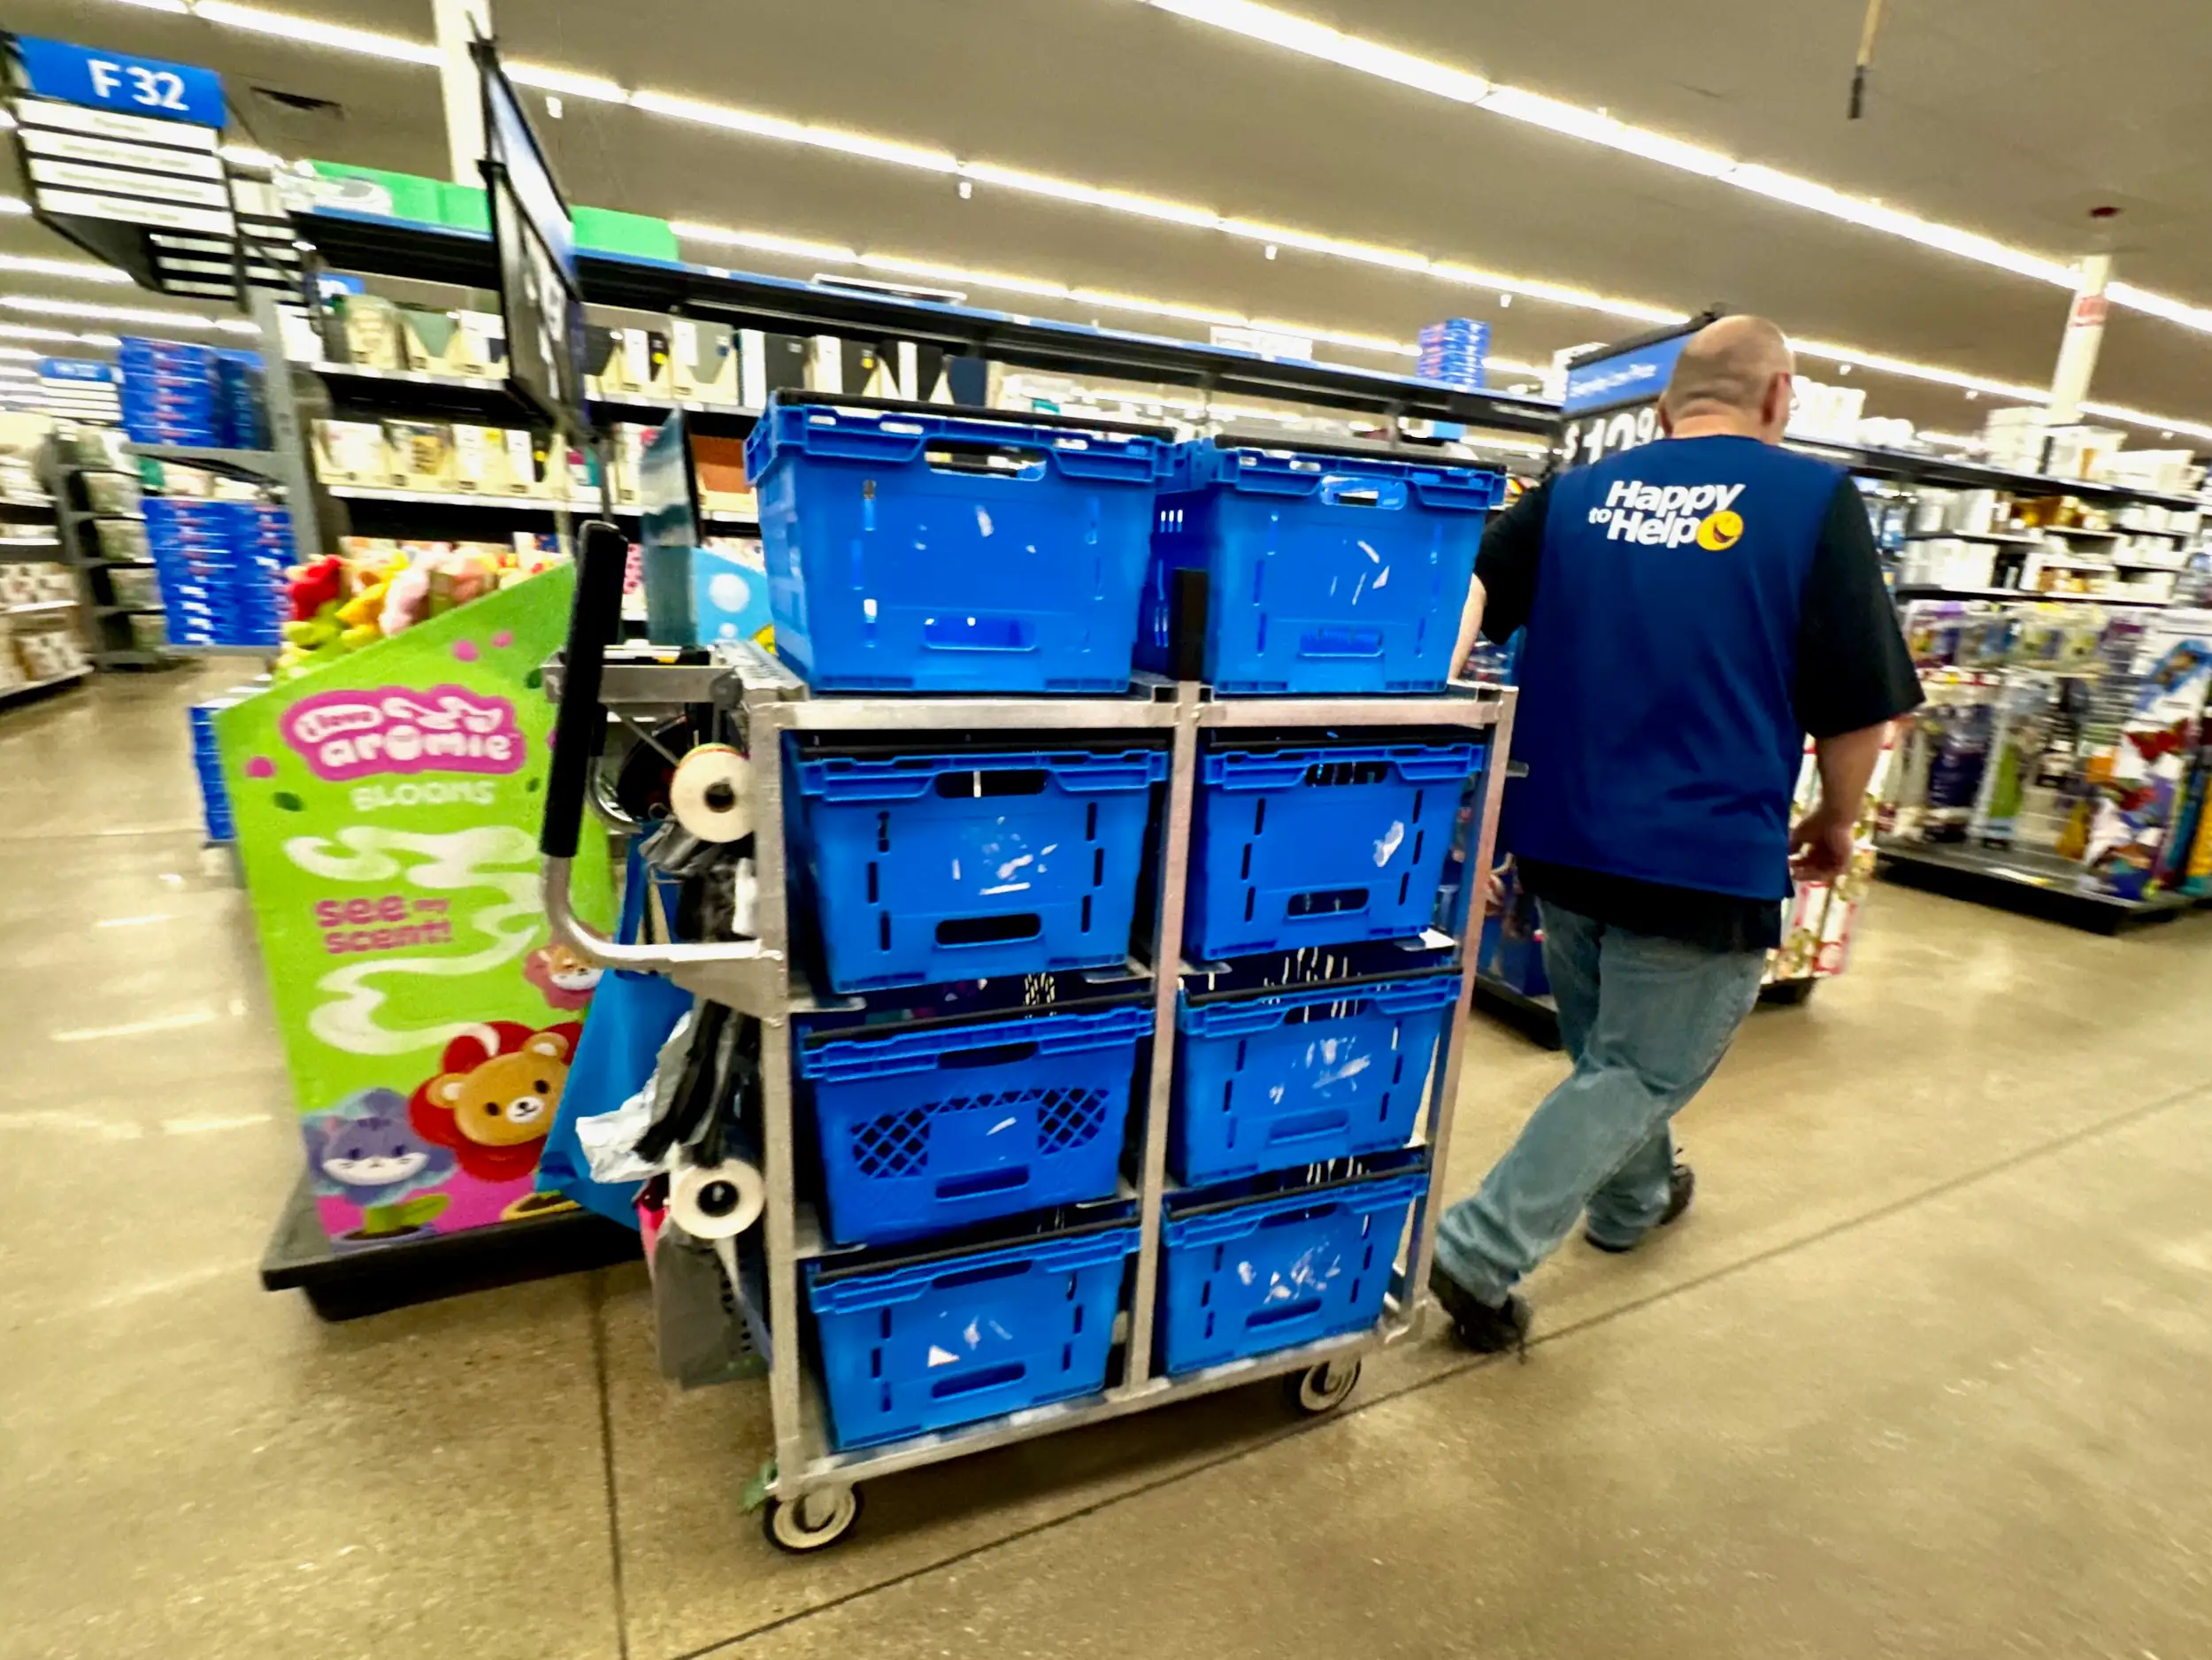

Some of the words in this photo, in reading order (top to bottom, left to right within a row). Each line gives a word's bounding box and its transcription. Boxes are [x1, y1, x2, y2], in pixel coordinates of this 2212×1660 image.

[87, 58, 122, 98] F
[126, 66, 190, 111] 32
[1605, 480, 1747, 519] Happy
[1587, 506, 1612, 525] to
[1606, 508, 1702, 549] Help
[315, 895, 408, 927] see
